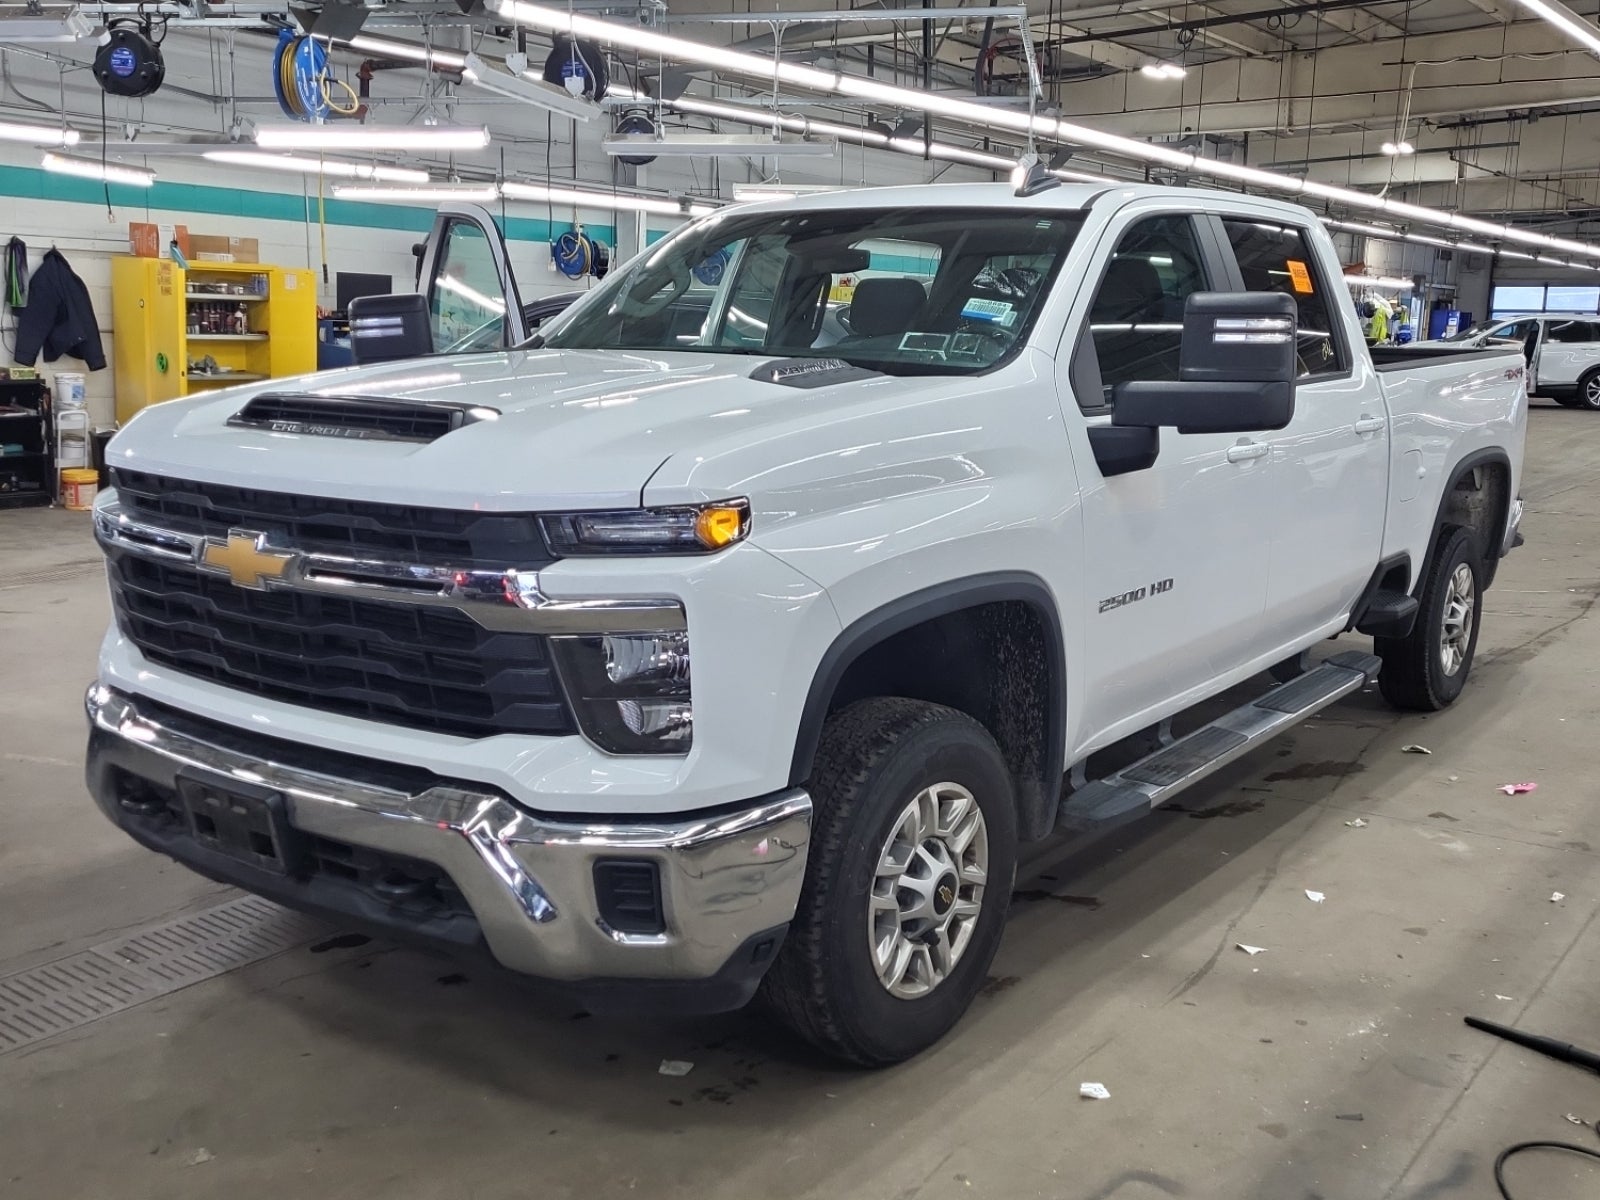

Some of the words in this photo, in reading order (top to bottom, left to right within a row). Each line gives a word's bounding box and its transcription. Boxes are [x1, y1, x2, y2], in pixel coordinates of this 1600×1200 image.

[271, 422, 371, 438] CHEVROLET
[1098, 586, 1146, 614] 2500
[1149, 578, 1174, 597] HD
